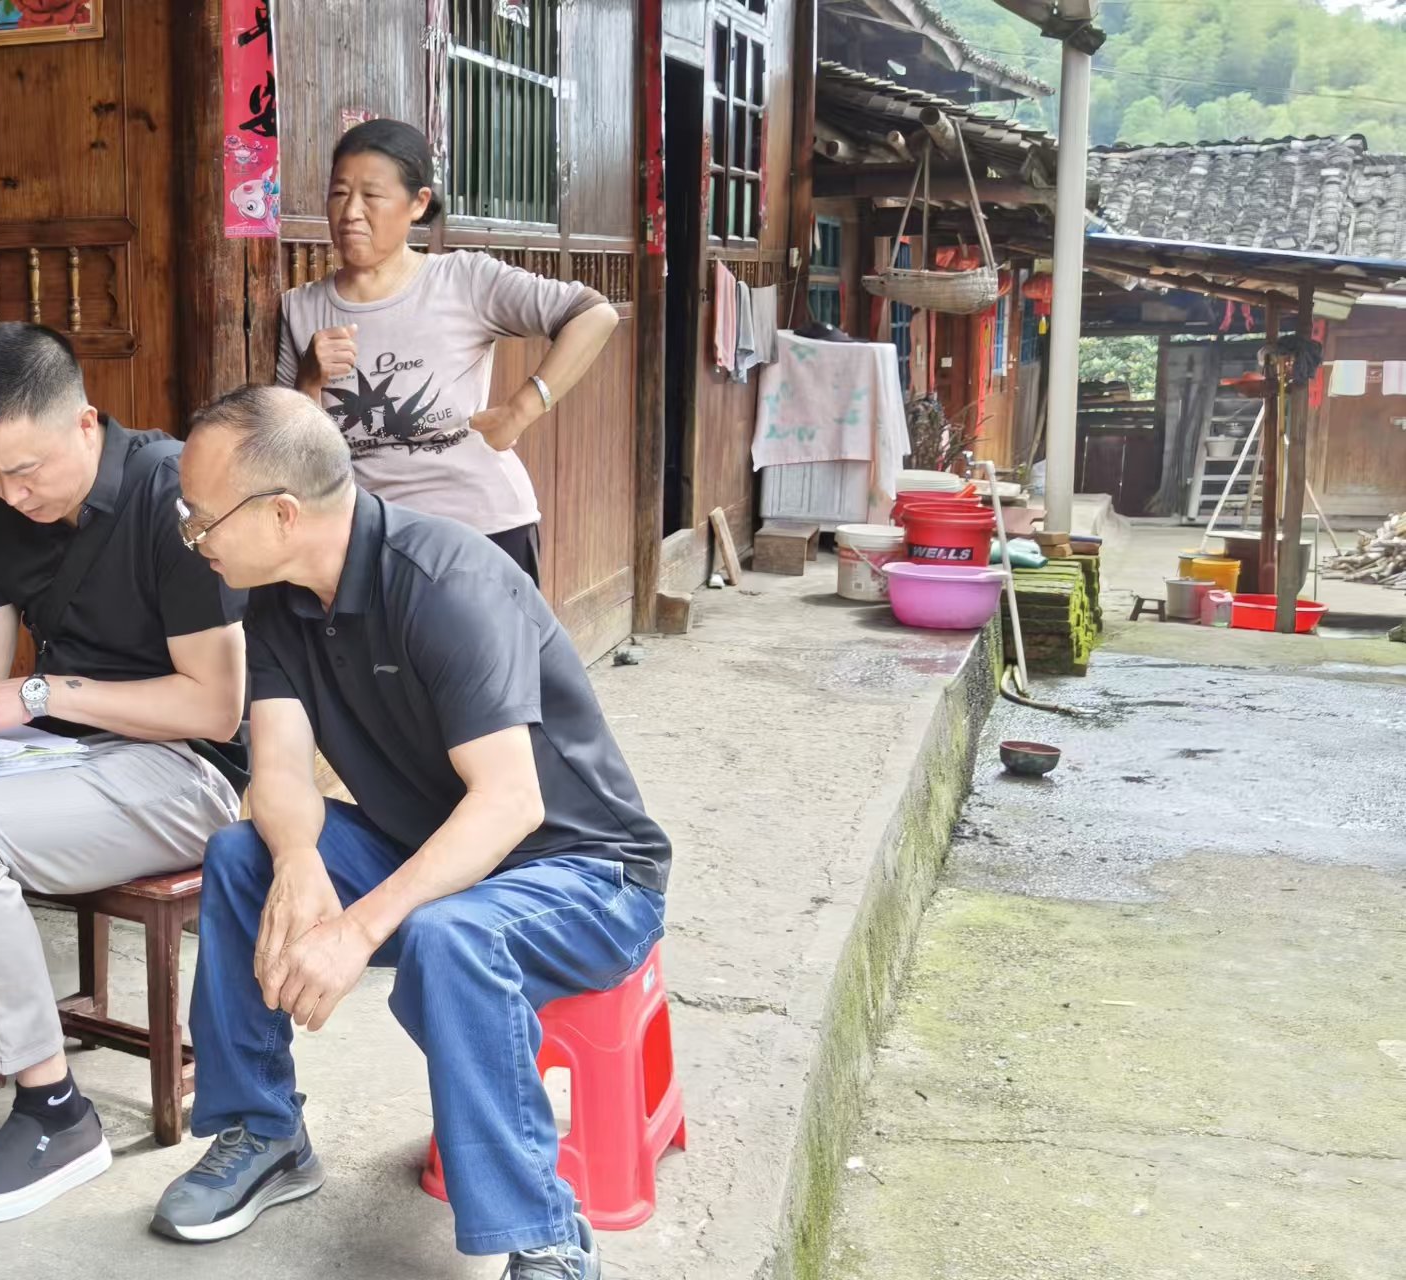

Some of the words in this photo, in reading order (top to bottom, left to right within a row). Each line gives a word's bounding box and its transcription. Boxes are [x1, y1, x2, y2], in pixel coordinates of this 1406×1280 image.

[370, 352, 424, 376] Love
[414, 407, 453, 425] OGUE
[913, 546, 971, 560] WELLS
